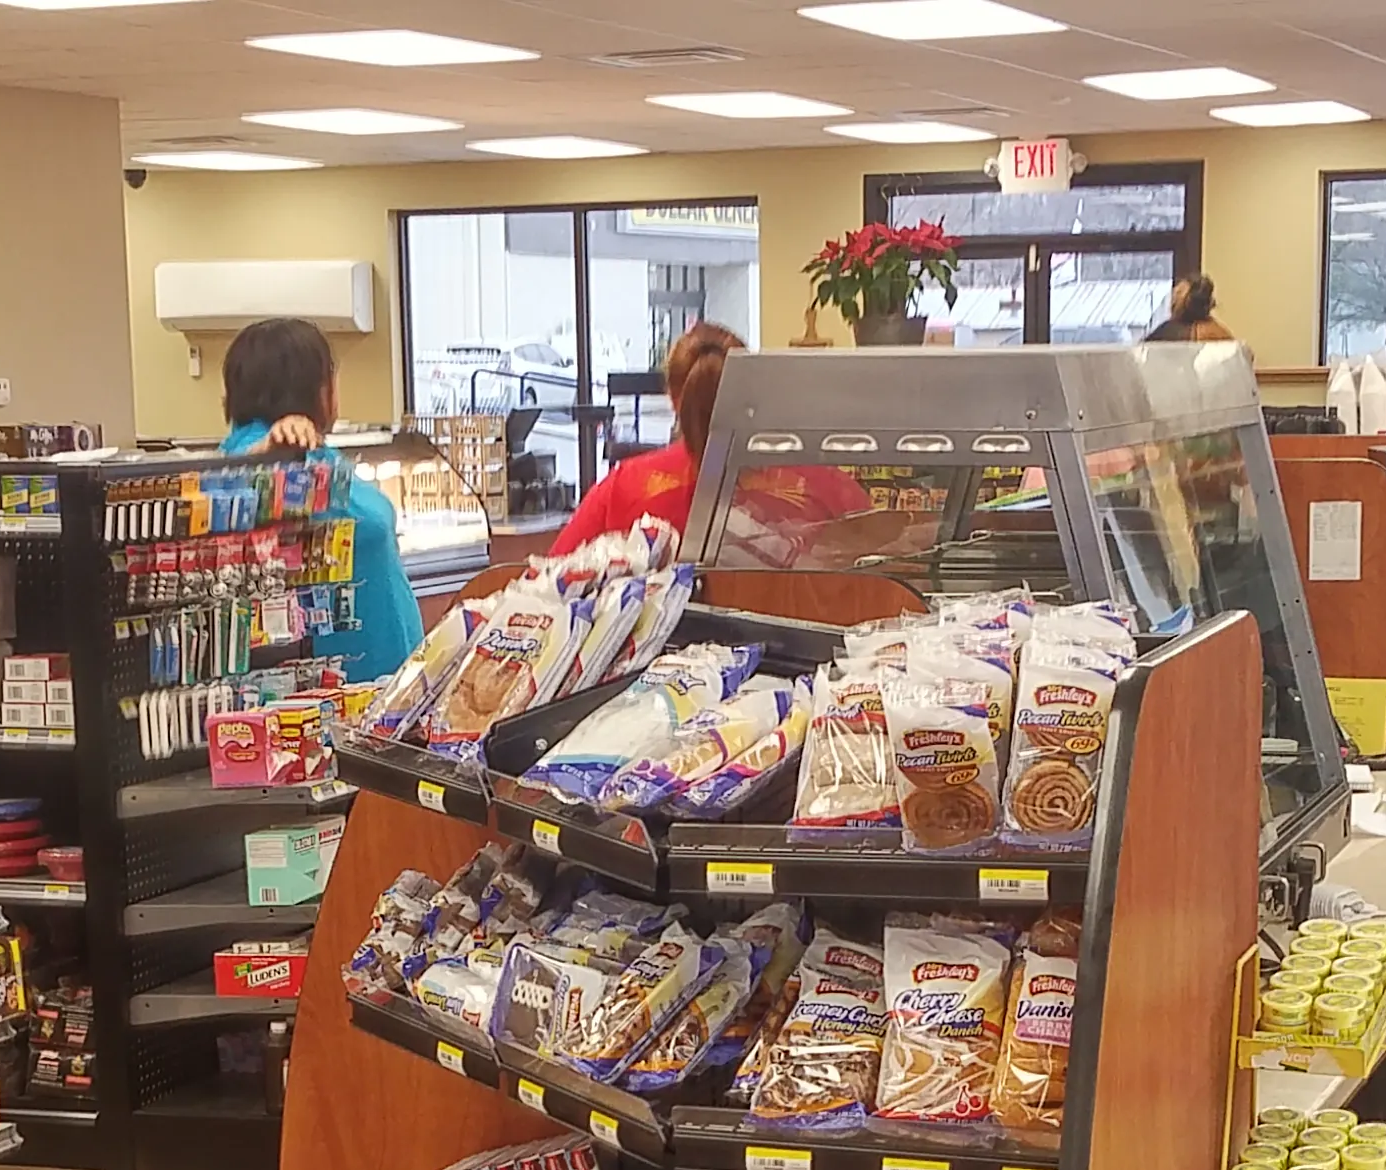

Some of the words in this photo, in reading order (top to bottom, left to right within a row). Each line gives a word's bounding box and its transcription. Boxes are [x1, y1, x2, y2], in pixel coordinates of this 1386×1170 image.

[1014, 143, 1058, 178] EXIT
[1039, 688, 1096, 706] Freshley's
[1017, 710, 1060, 726] Pecan
[1060, 710, 1103, 727] Twirls
[908, 733, 963, 747] Freshley's
[897, 752, 935, 768] Pecan
[935, 748, 977, 765] Twirls
[249, 962, 291, 987] LUDEN'S
[916, 963, 979, 982] Freshley's
[895, 990, 964, 1010] Cherry
[814, 1016, 855, 1032] Honey
[920, 1007, 984, 1026] Cheese
[939, 1024, 984, 1038] Danish
